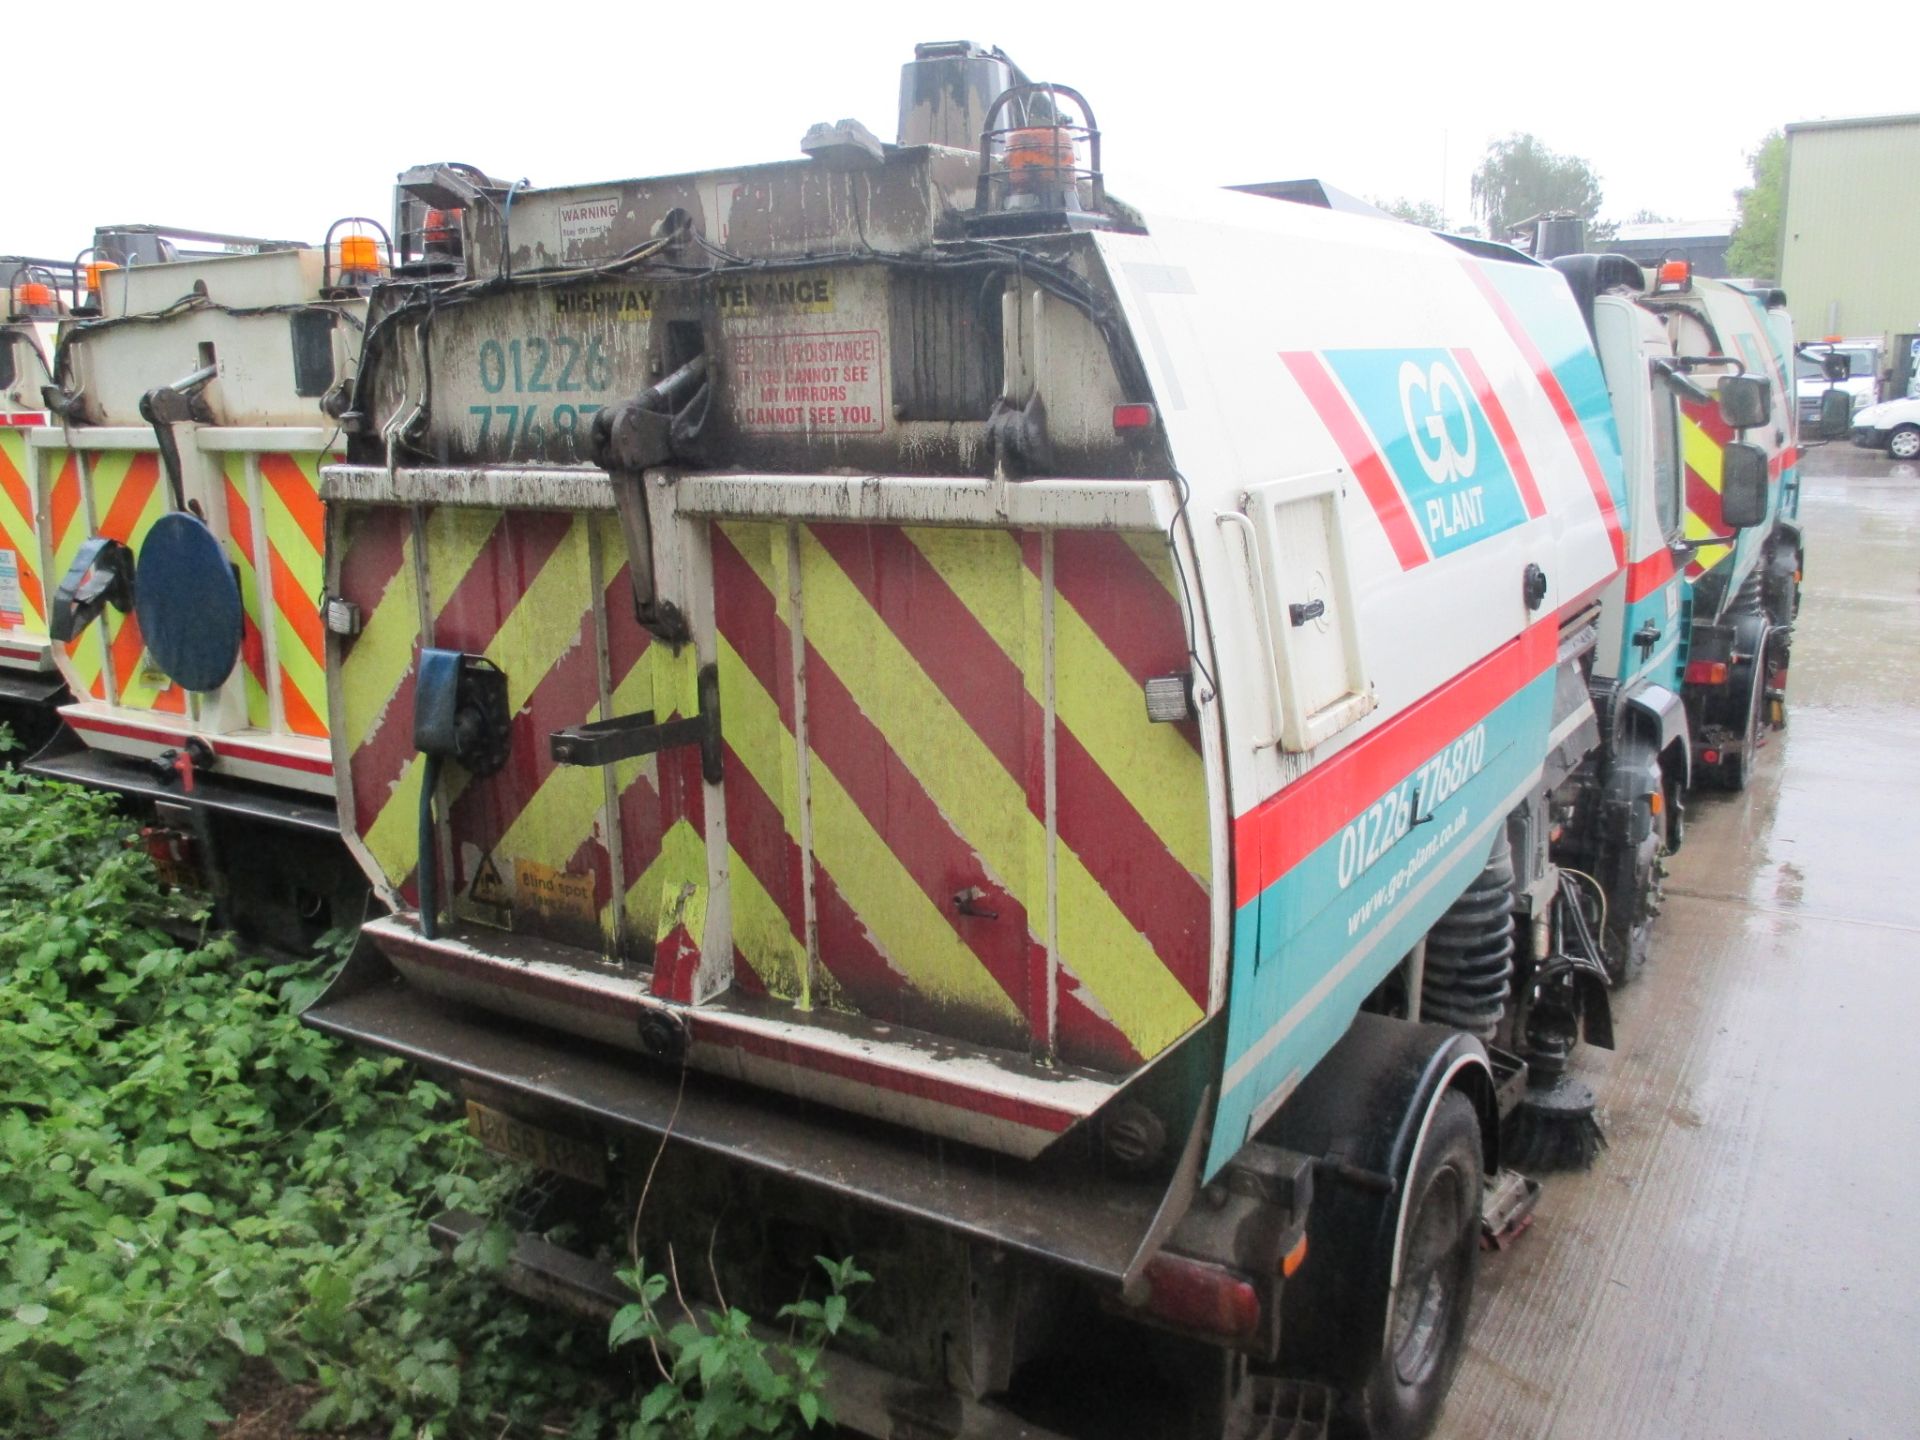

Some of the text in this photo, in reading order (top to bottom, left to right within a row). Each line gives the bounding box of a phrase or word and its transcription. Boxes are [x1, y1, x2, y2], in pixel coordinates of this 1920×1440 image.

[561, 204, 617, 222] WARNING
[555, 290, 653, 312] HIGHWAY
[804, 340, 875, 362] DISTANCE!
[480, 335, 612, 393] 01226
[786, 368, 839, 384] CANNOT
[843, 366, 869, 382] SEE
[761, 386, 846, 402] MY MIRRORS
[746, 408, 804, 424] CANNOT
[809, 407, 836, 424] SEE
[841, 406, 876, 423] YOU.
[1398, 361, 1477, 484] GO
[1425, 486, 1485, 542] PLANT
[1338, 723, 1486, 889] 01226 776870
[1348, 806, 1468, 936] www.go-plant.co.uk
[522, 873, 588, 898] Blind spot
